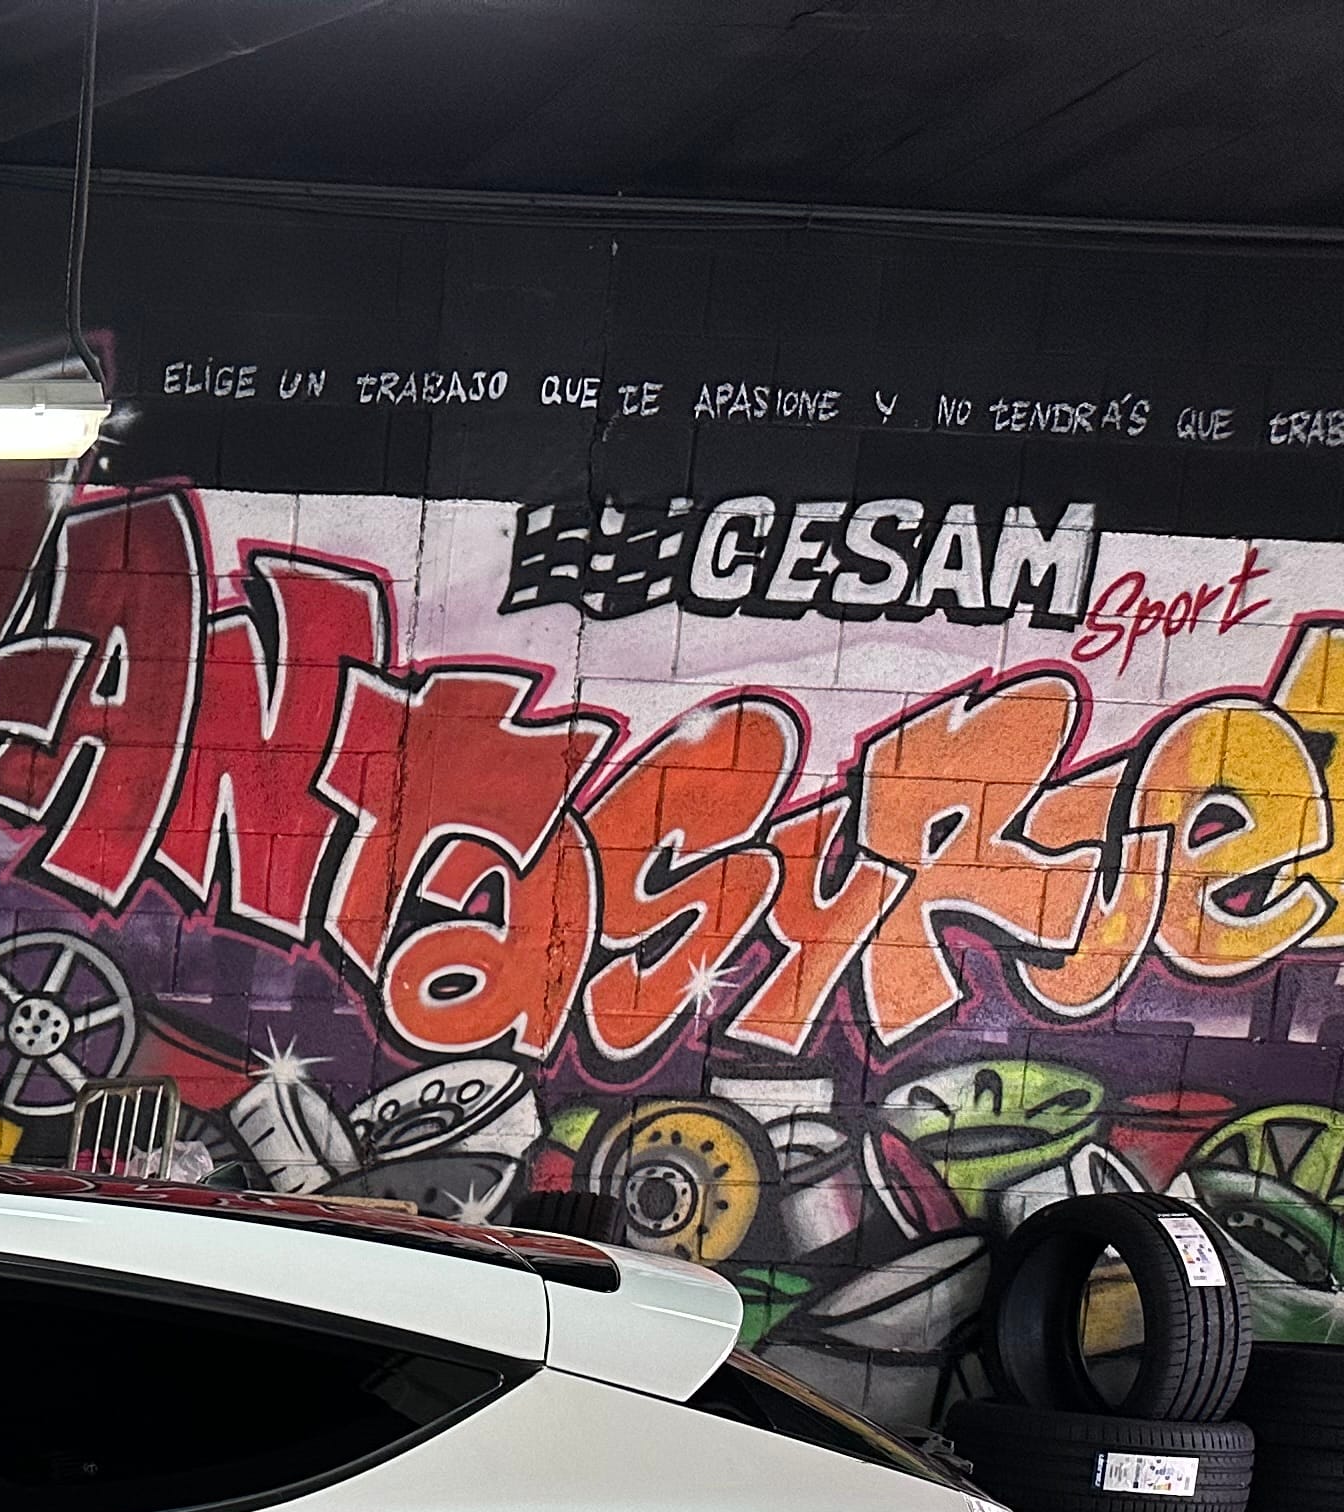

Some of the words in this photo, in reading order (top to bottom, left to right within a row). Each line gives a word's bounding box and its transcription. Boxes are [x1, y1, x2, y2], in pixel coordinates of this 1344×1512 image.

[279, 368, 327, 400] UN
[540, 374, 602, 410] QUE
[693, 381, 843, 423] APASIONE
[936, 394, 972, 428] NO
[1176, 407, 1234, 443] QUE
[684, 497, 1102, 632] CESAM
[1072, 548, 1278, 676] Sport
